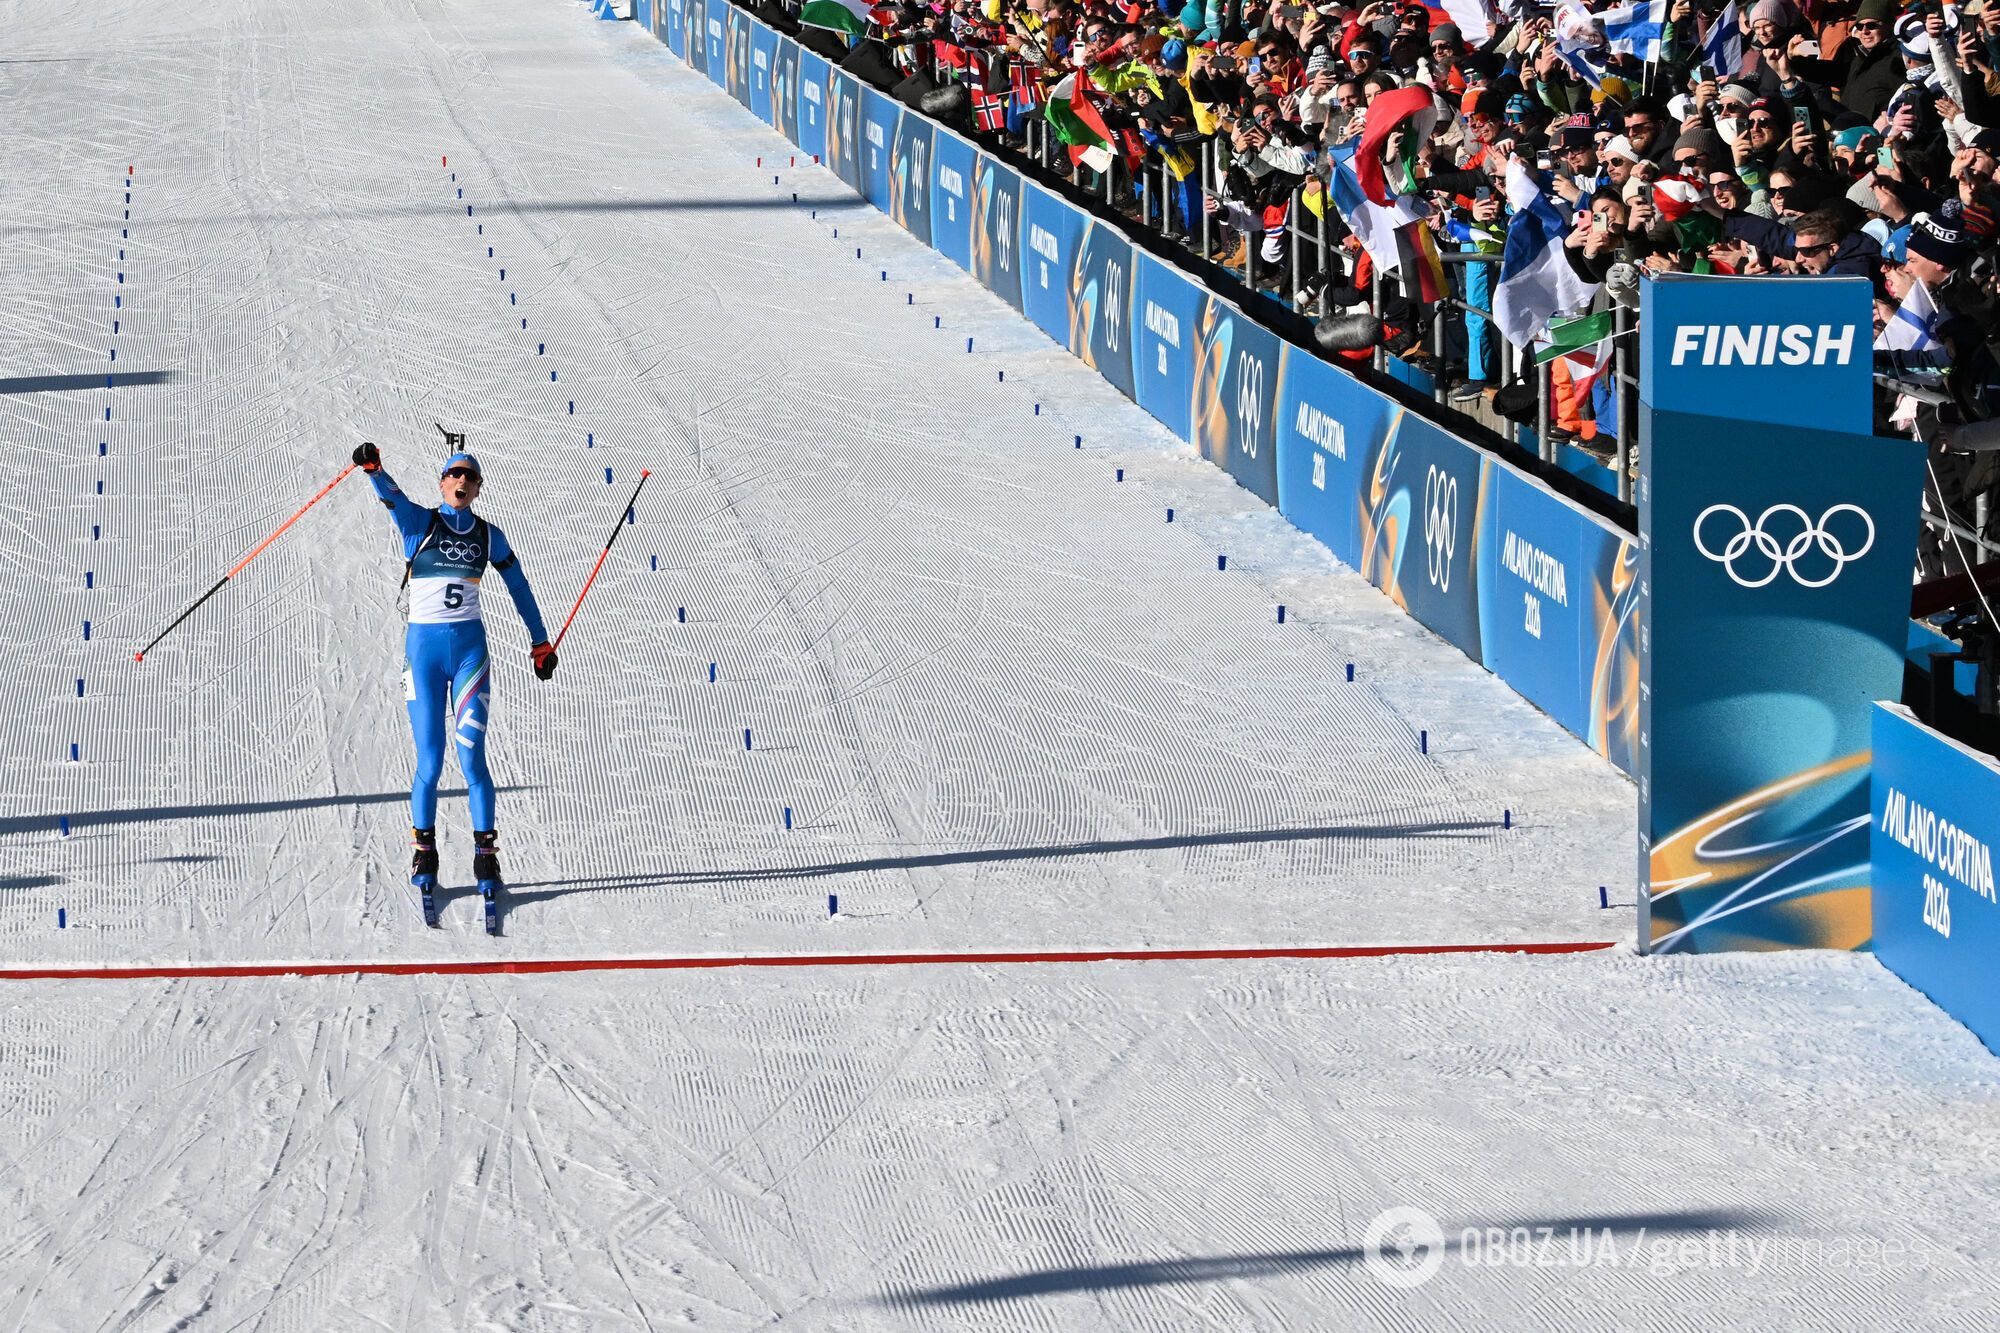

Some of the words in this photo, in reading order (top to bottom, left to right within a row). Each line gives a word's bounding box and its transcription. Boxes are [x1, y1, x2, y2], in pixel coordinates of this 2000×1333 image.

[1925, 223, 1957, 241] AND
[1671, 324, 1855, 365] FINISH
[1296, 400, 1321, 445] MILANO
[1502, 529, 1532, 583] MILANO
[1533, 548, 1568, 608] CORTINA
[443, 583, 464, 609] 5
[1524, 592, 1541, 640] 2026
[1881, 787, 1936, 863] MILANO
[1938, 818, 1996, 904] CORTINA
[1923, 873, 1950, 939] 2026
